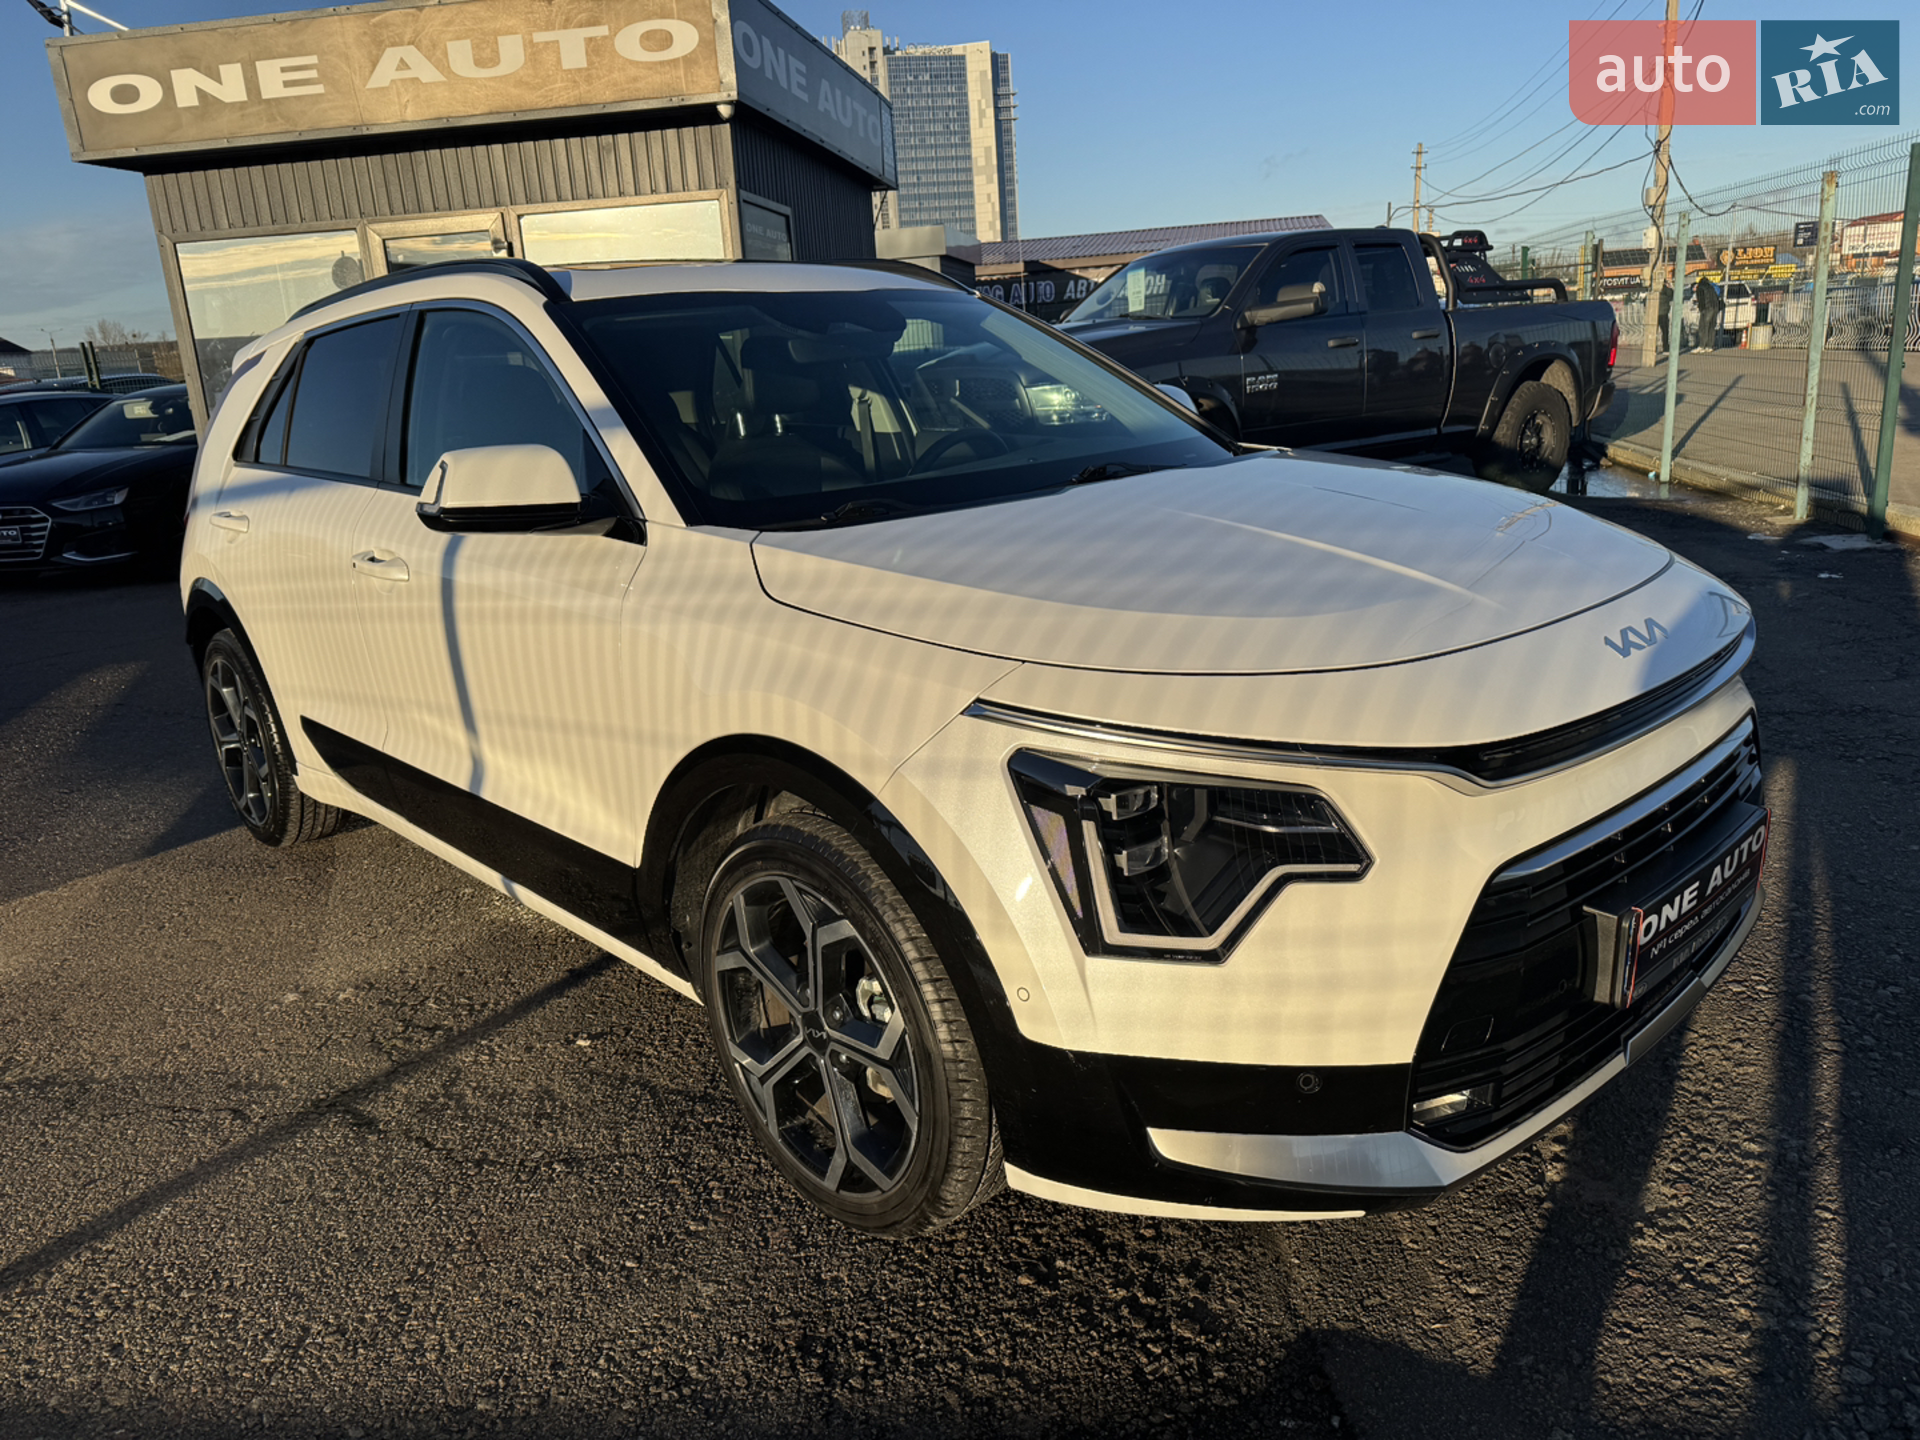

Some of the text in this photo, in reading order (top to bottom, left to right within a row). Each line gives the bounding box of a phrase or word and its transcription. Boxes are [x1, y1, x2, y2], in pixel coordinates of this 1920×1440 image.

[87, 19, 699, 114] ONE AUTO
[733, 20, 881, 147] ONE AUTO
[746, 223, 788, 242] ONE AUTO
[1603, 617, 1668, 658] KIA
[1640, 881, 1700, 945] ONE
[1705, 825, 1765, 896] AUTO
